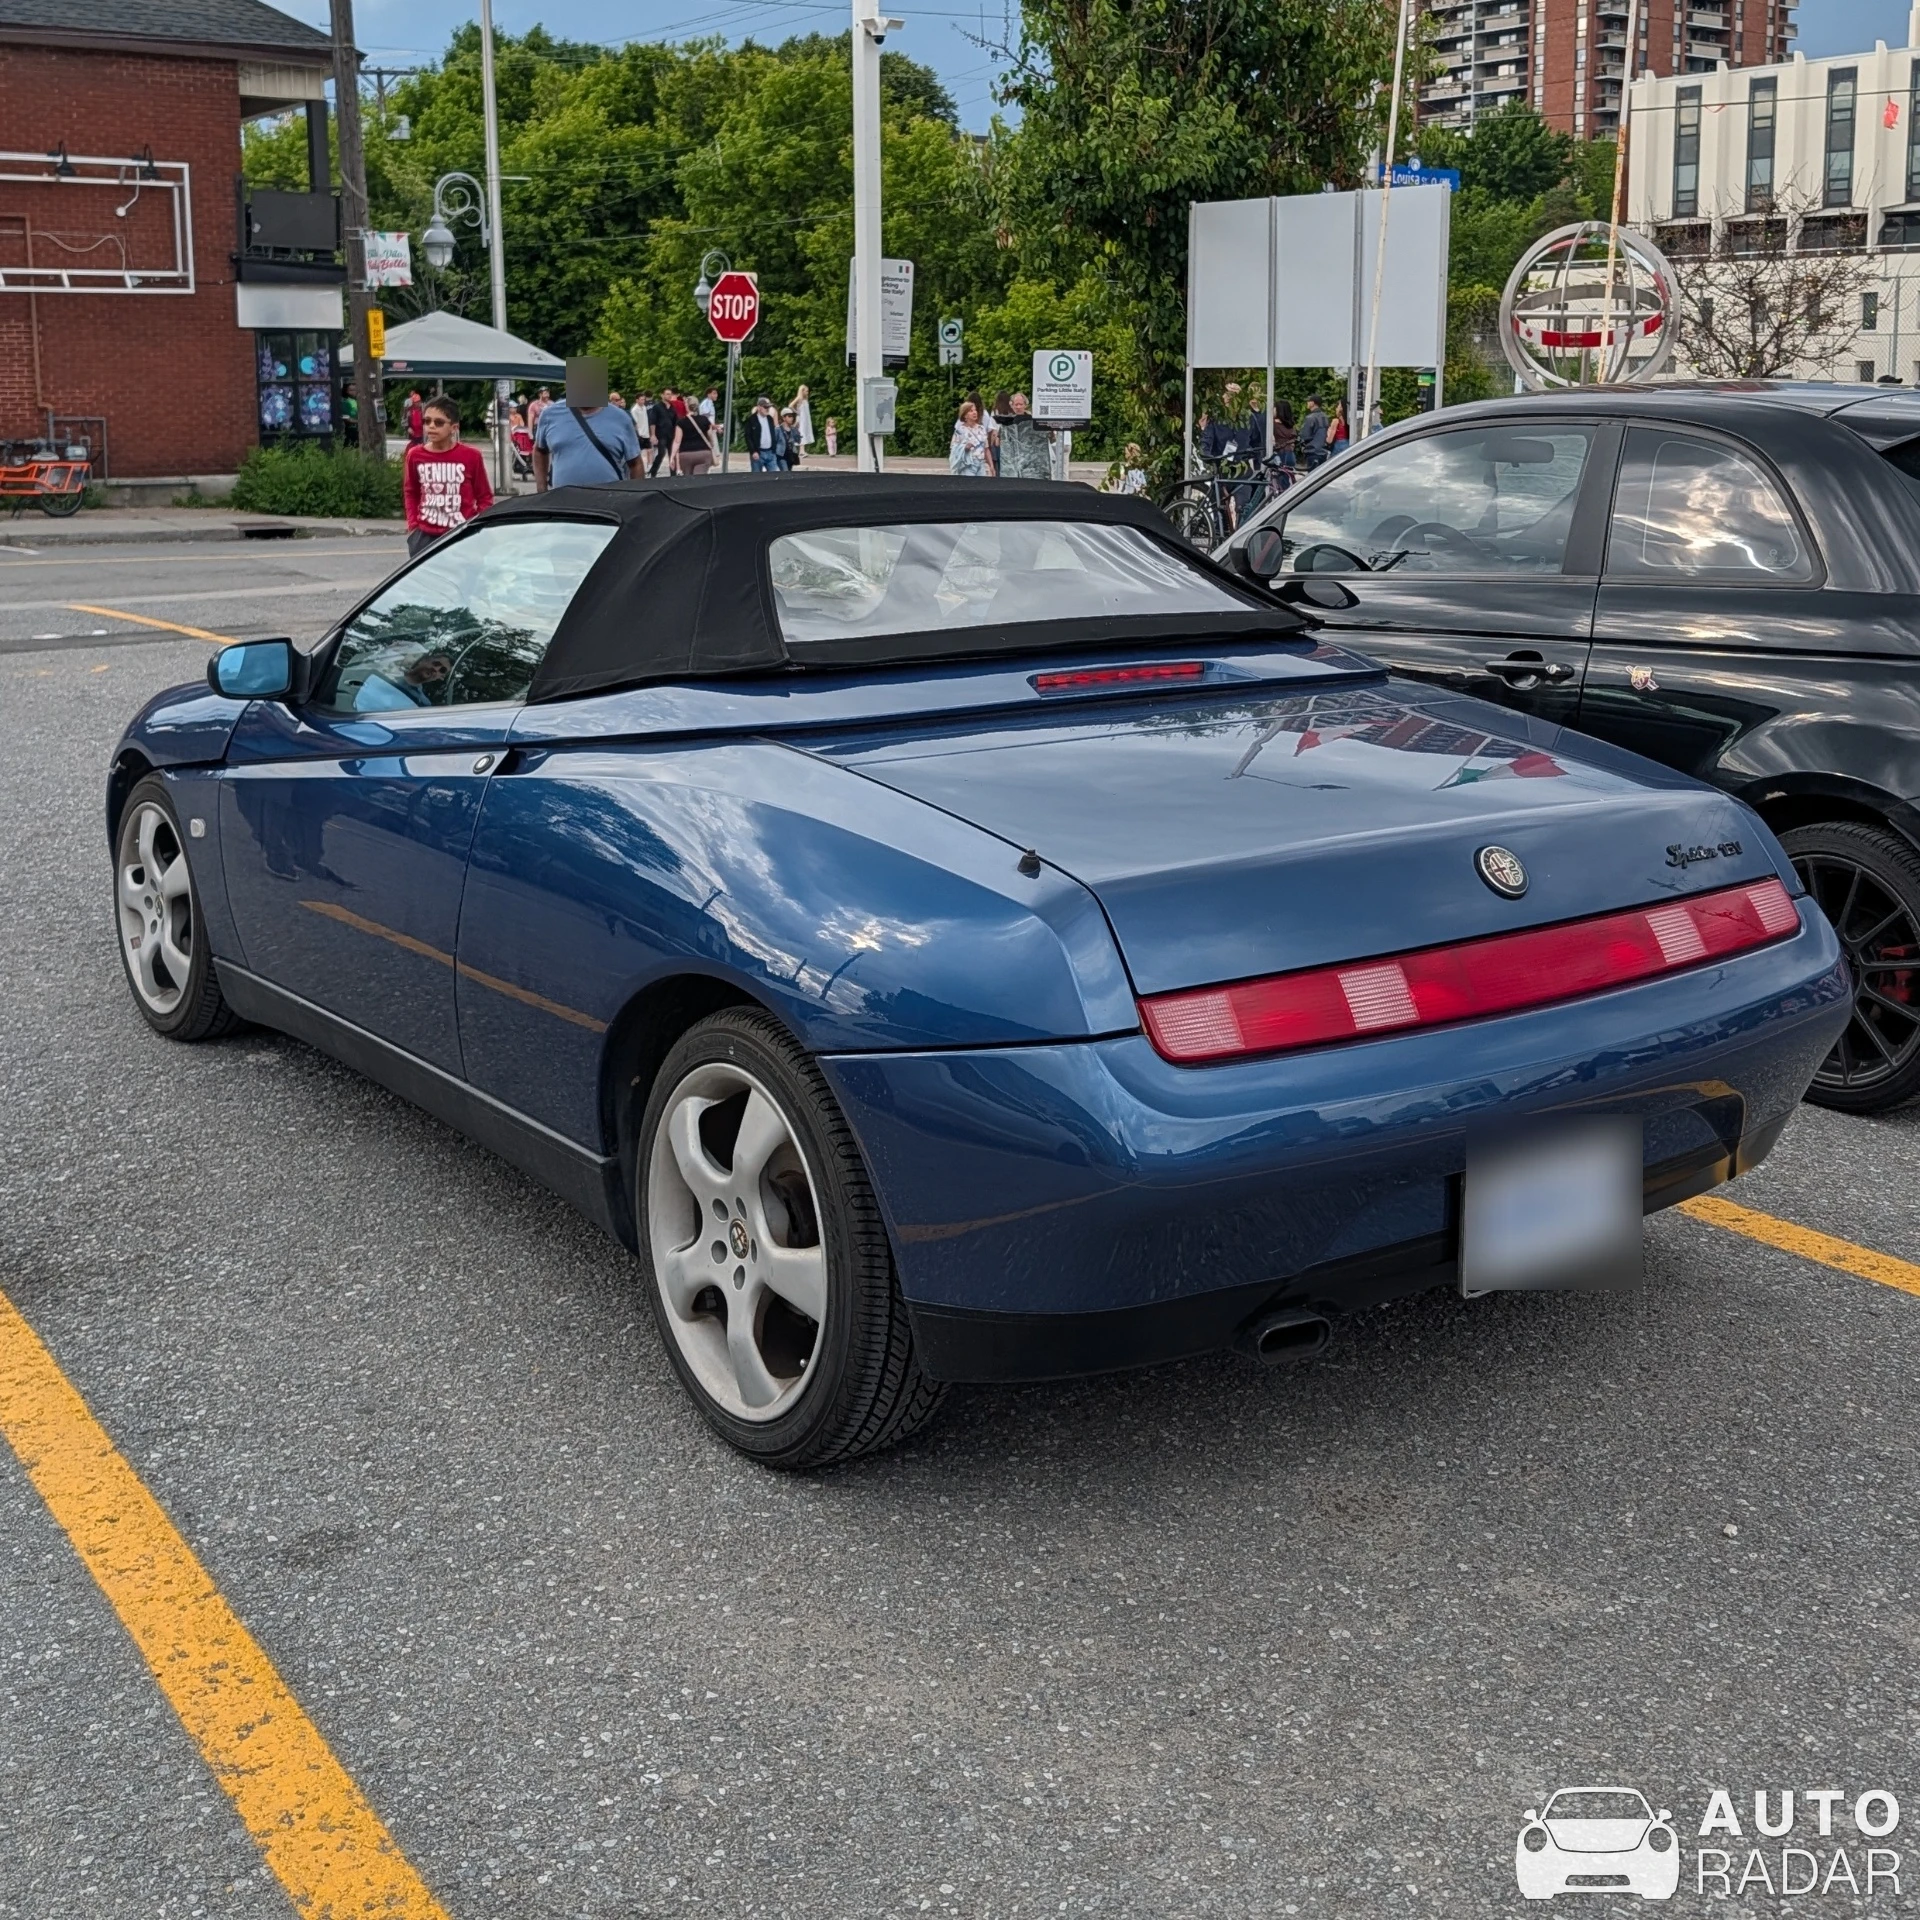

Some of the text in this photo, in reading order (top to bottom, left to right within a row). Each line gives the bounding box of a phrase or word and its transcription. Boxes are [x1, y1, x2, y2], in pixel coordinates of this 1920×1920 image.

[1392, 170, 1420, 185] Louisa
[712, 294, 755, 320] STOP
[1056, 361, 1069, 375] P
[417, 462, 466, 484] GENIUS
[446, 483, 461, 495] MY
